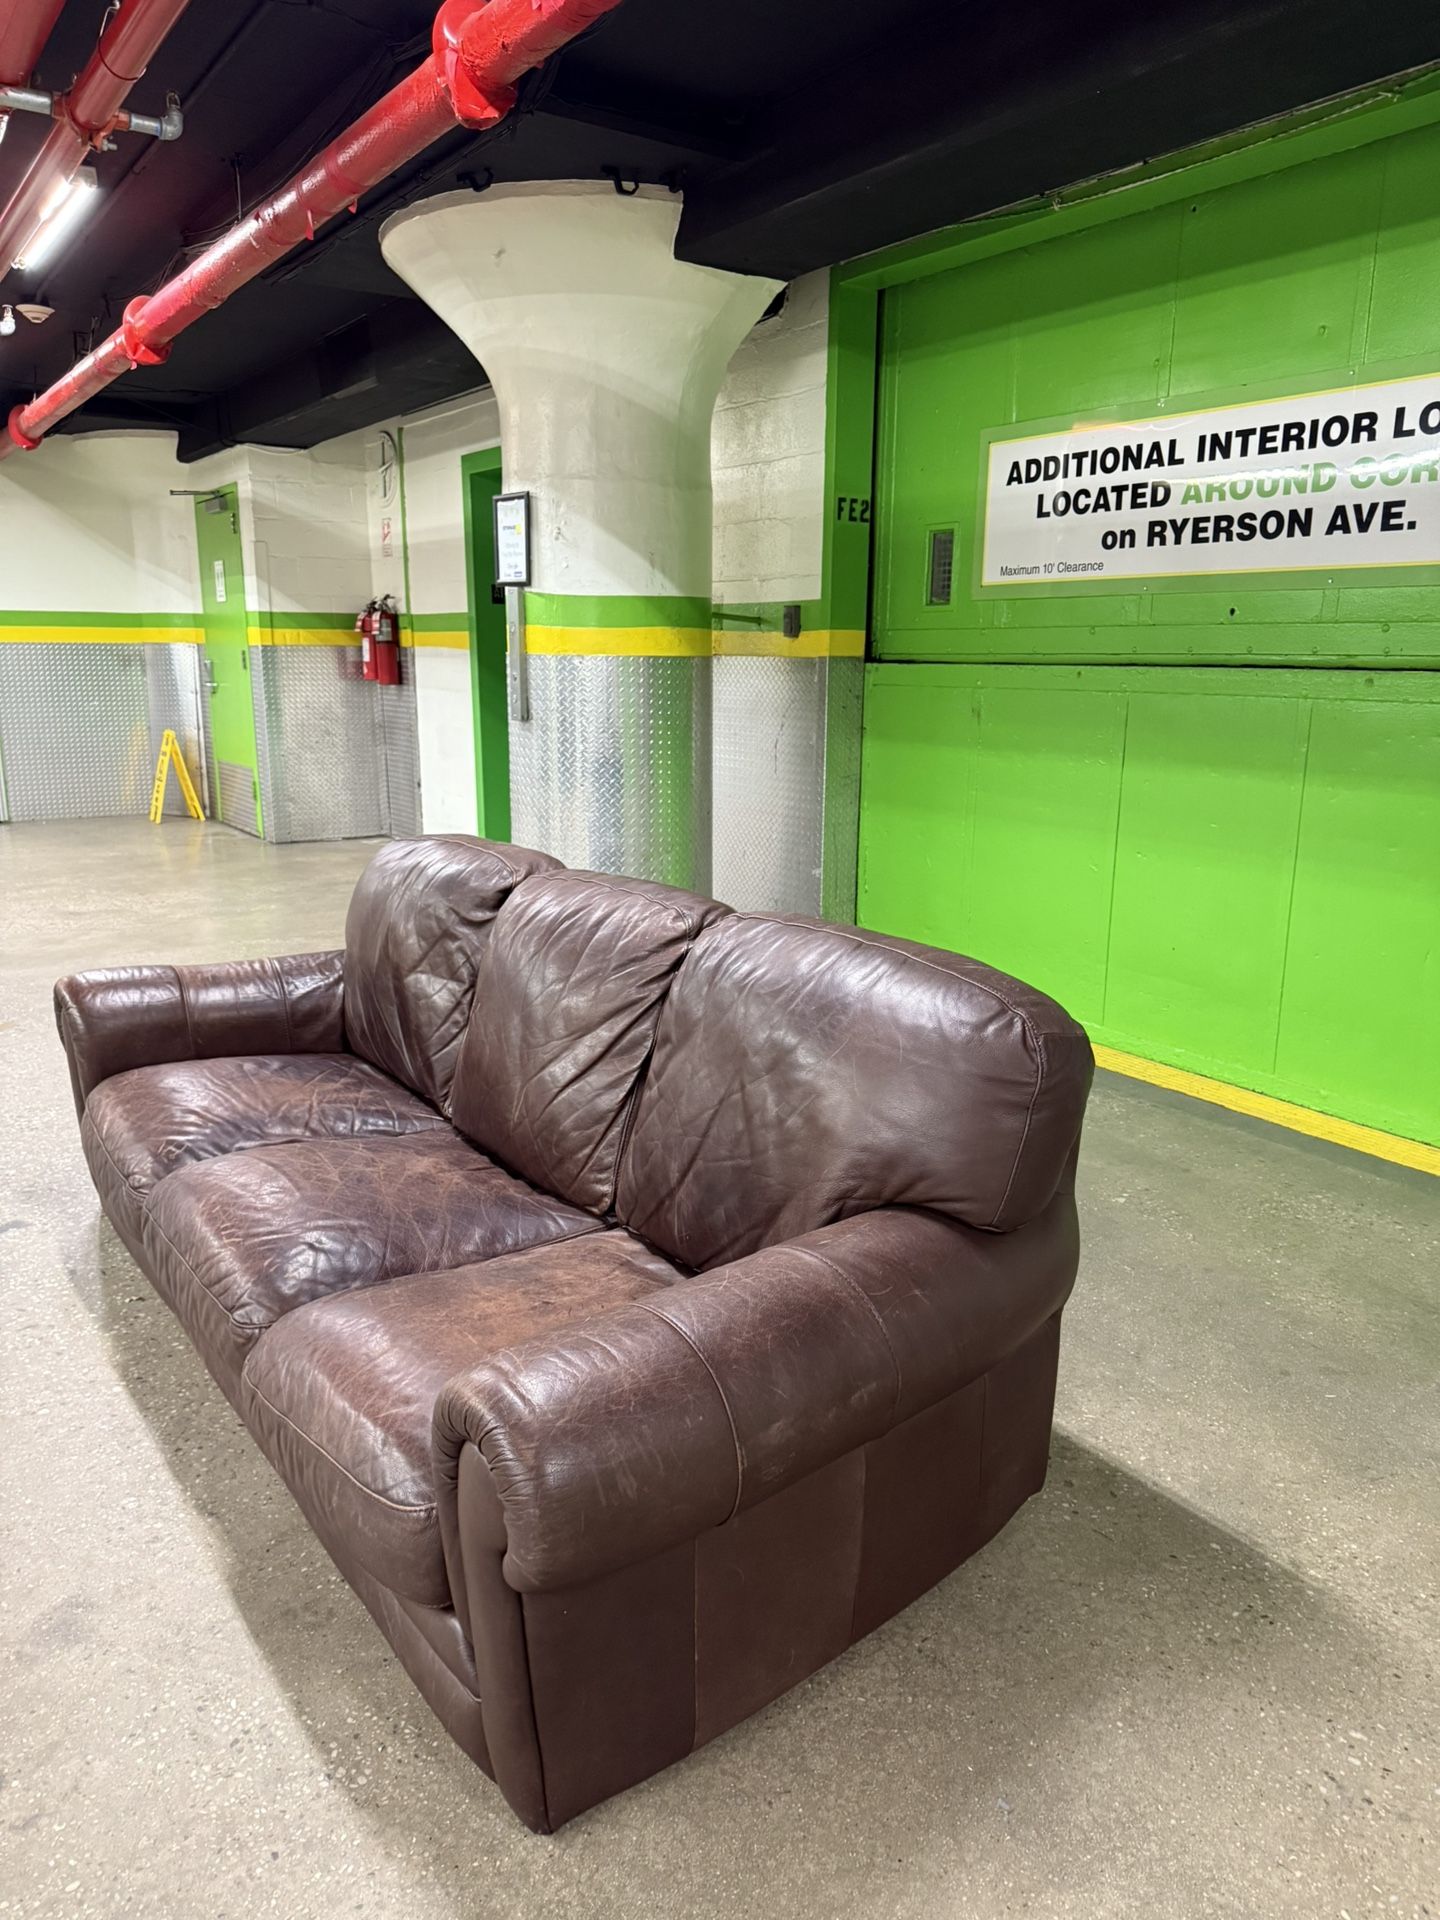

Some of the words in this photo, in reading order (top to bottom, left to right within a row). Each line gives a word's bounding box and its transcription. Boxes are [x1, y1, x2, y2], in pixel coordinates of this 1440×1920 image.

[1006, 439, 1184, 486] ADDITIONAL
[1197, 411, 1379, 463] INTERIOR
[837, 497, 870, 523] FE2
[1036, 480, 1172, 518] LOCATED
[1180, 461, 1338, 505] AROUND
[1101, 528, 1136, 550] on
[1147, 507, 1314, 547] RYERSON
[1324, 500, 1417, 536] AVE.
[1000, 564, 1040, 576] Maximum
[1042, 563, 1055, 575] 10'
[1056, 561, 1104, 573] Clearance
